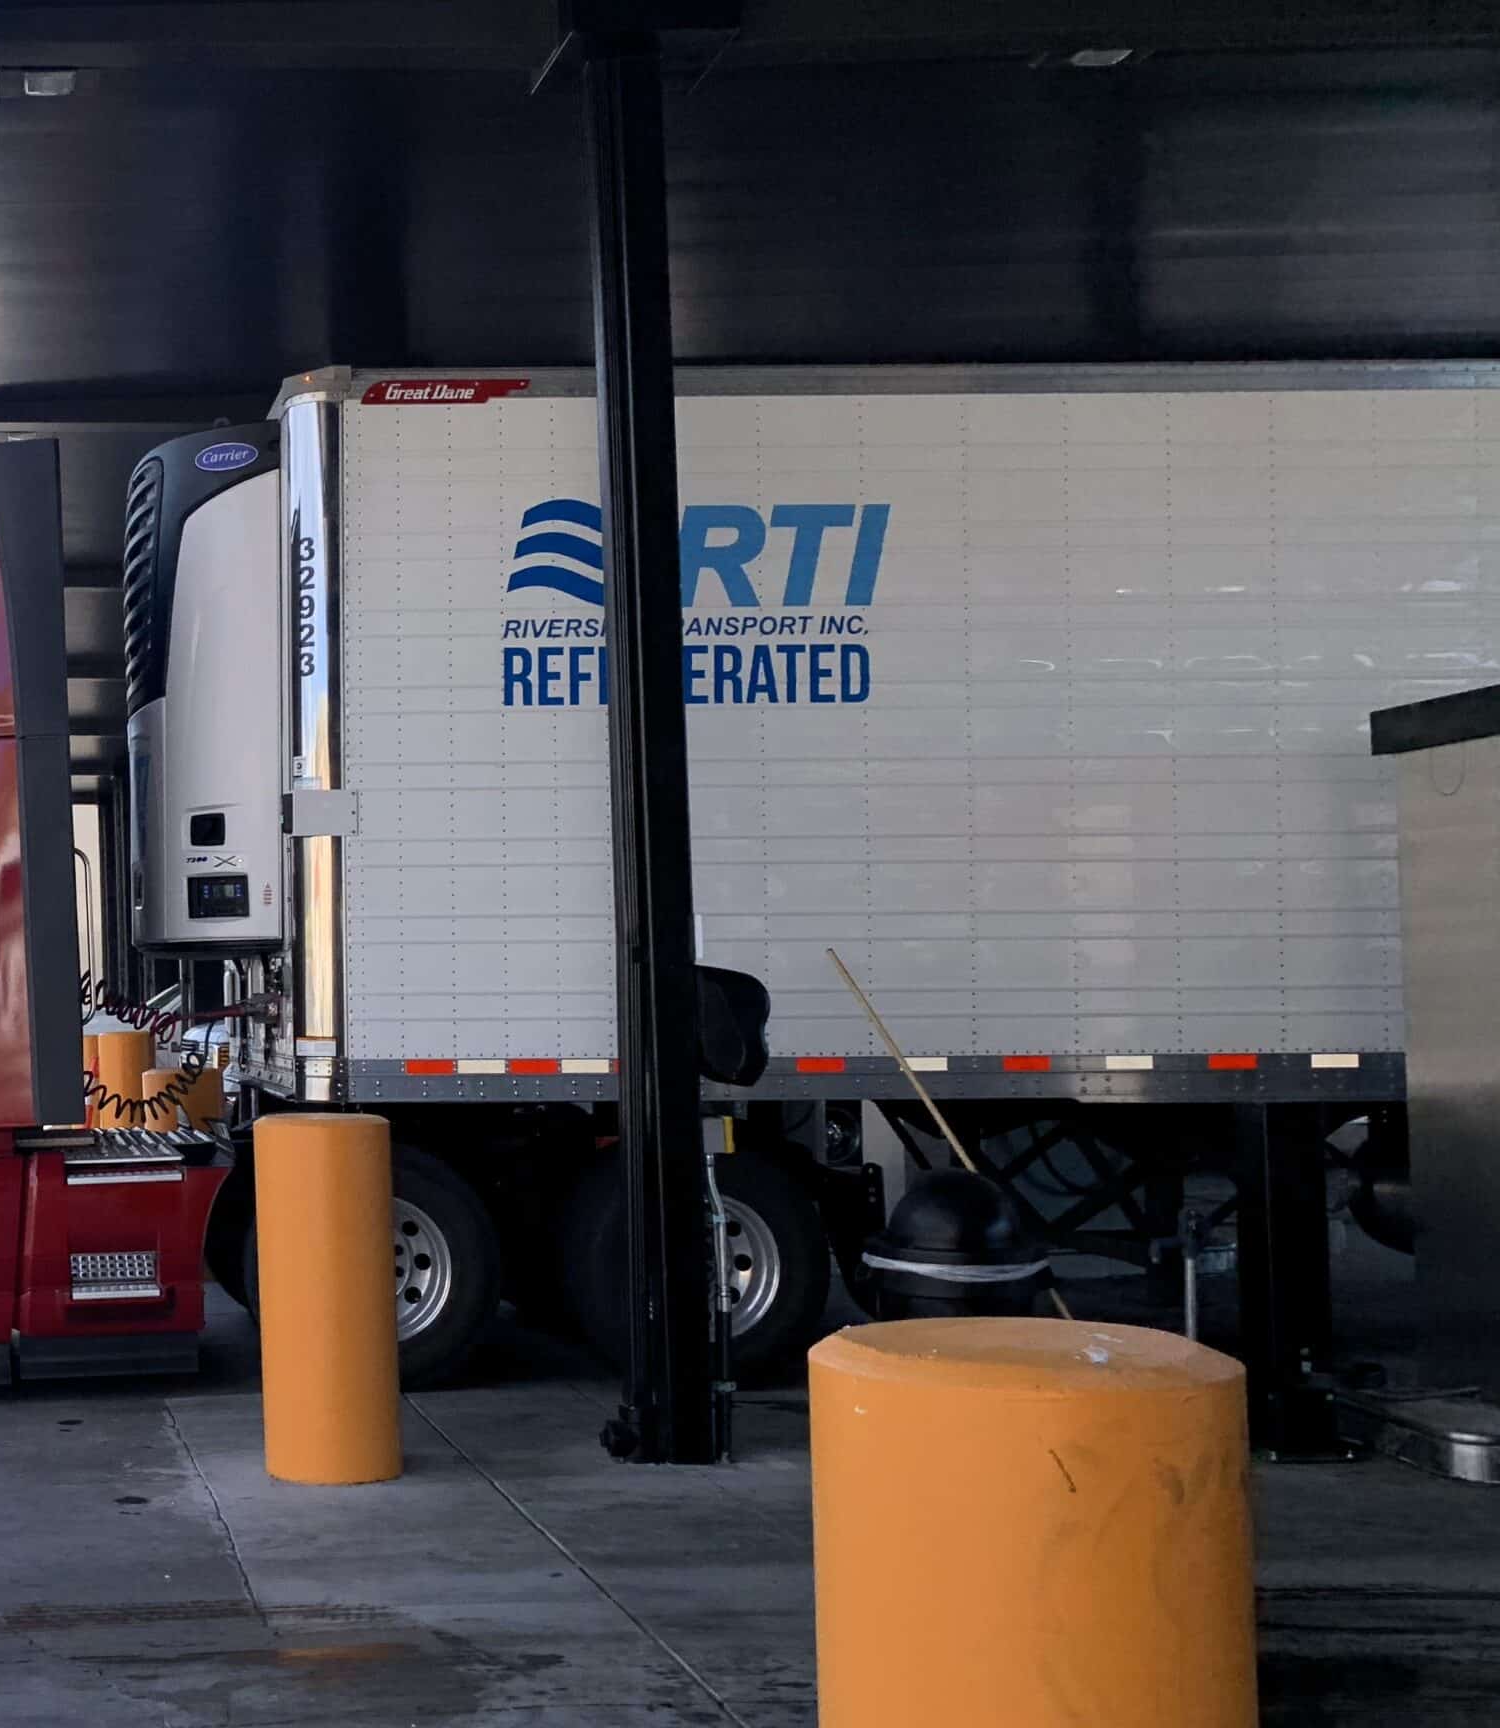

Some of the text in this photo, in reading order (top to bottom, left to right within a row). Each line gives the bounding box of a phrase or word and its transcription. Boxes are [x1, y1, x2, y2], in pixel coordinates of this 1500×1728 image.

[385, 383, 475, 400] Great Dane
[203, 449, 249, 464] Carrier
[680, 504, 890, 608] RTI
[299, 537, 316, 677] 32923
[682, 616, 813, 636] ANSPORT
[503, 644, 870, 706] REFERATED
